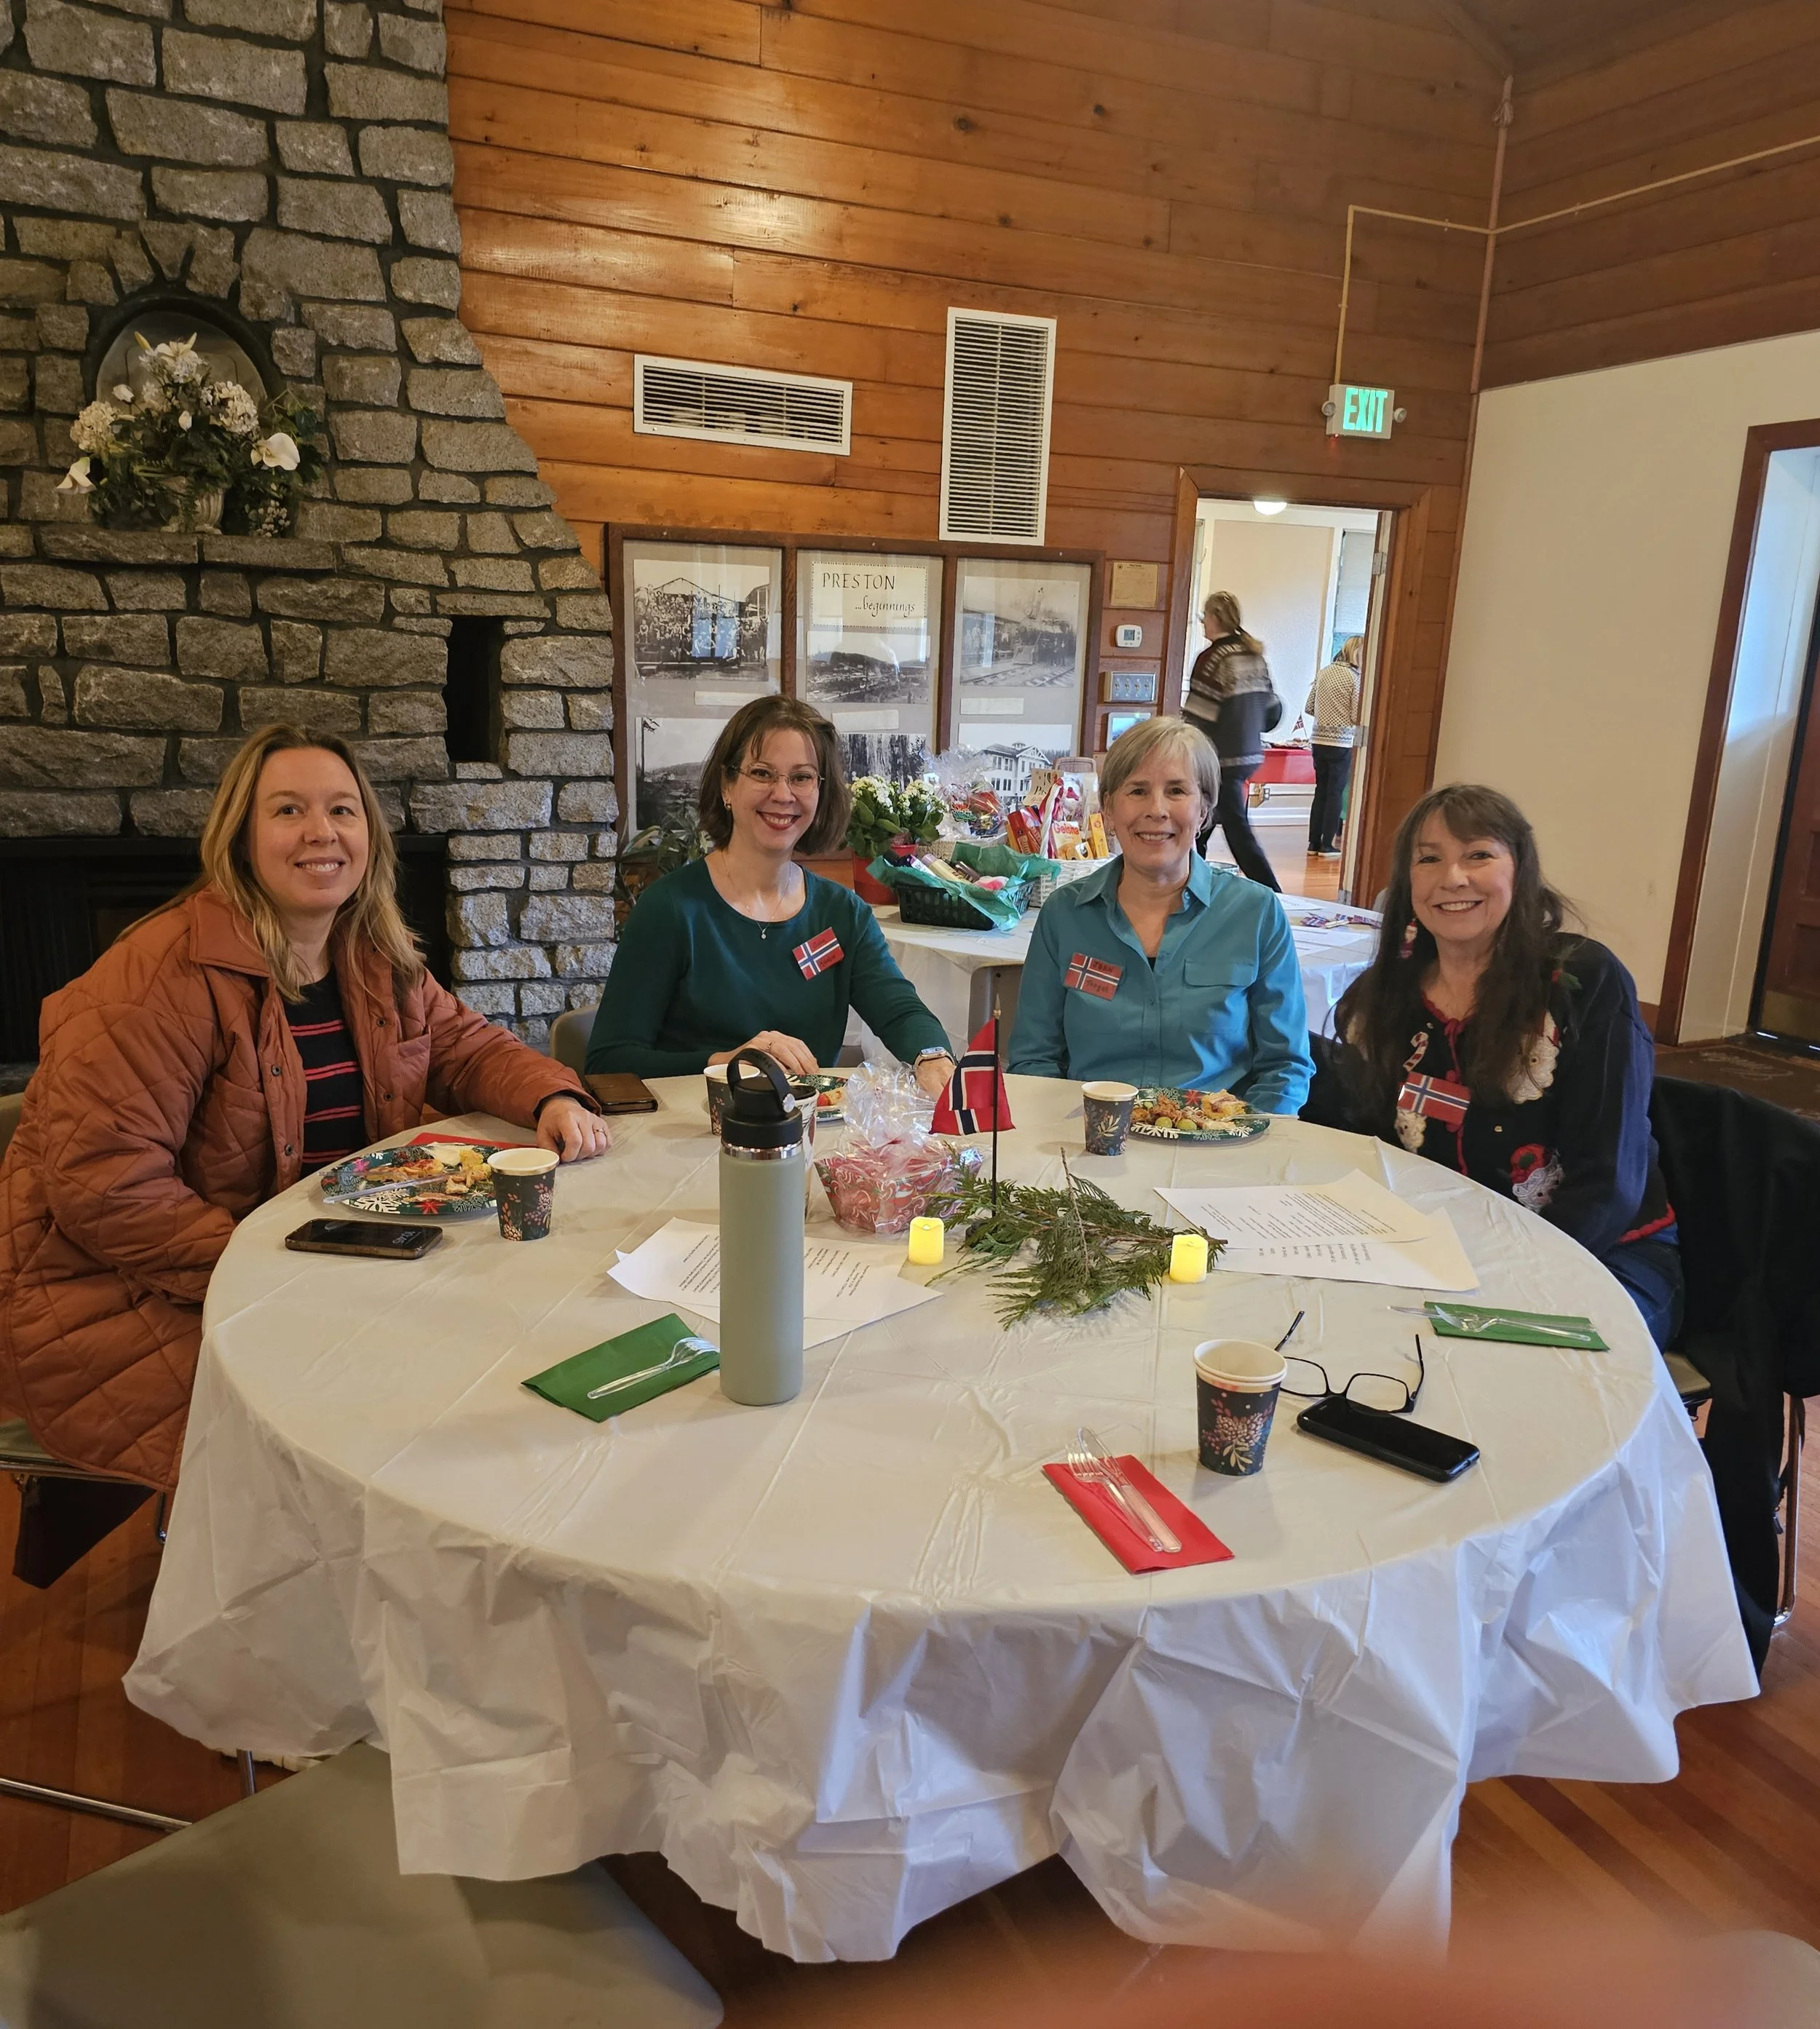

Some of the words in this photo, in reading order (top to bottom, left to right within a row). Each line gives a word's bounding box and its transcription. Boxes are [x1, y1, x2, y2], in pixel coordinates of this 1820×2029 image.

[1342, 387, 1388, 433] EXIT
[822, 571, 896, 590] PRESTON
[1054, 823, 1080, 835] Geisha
